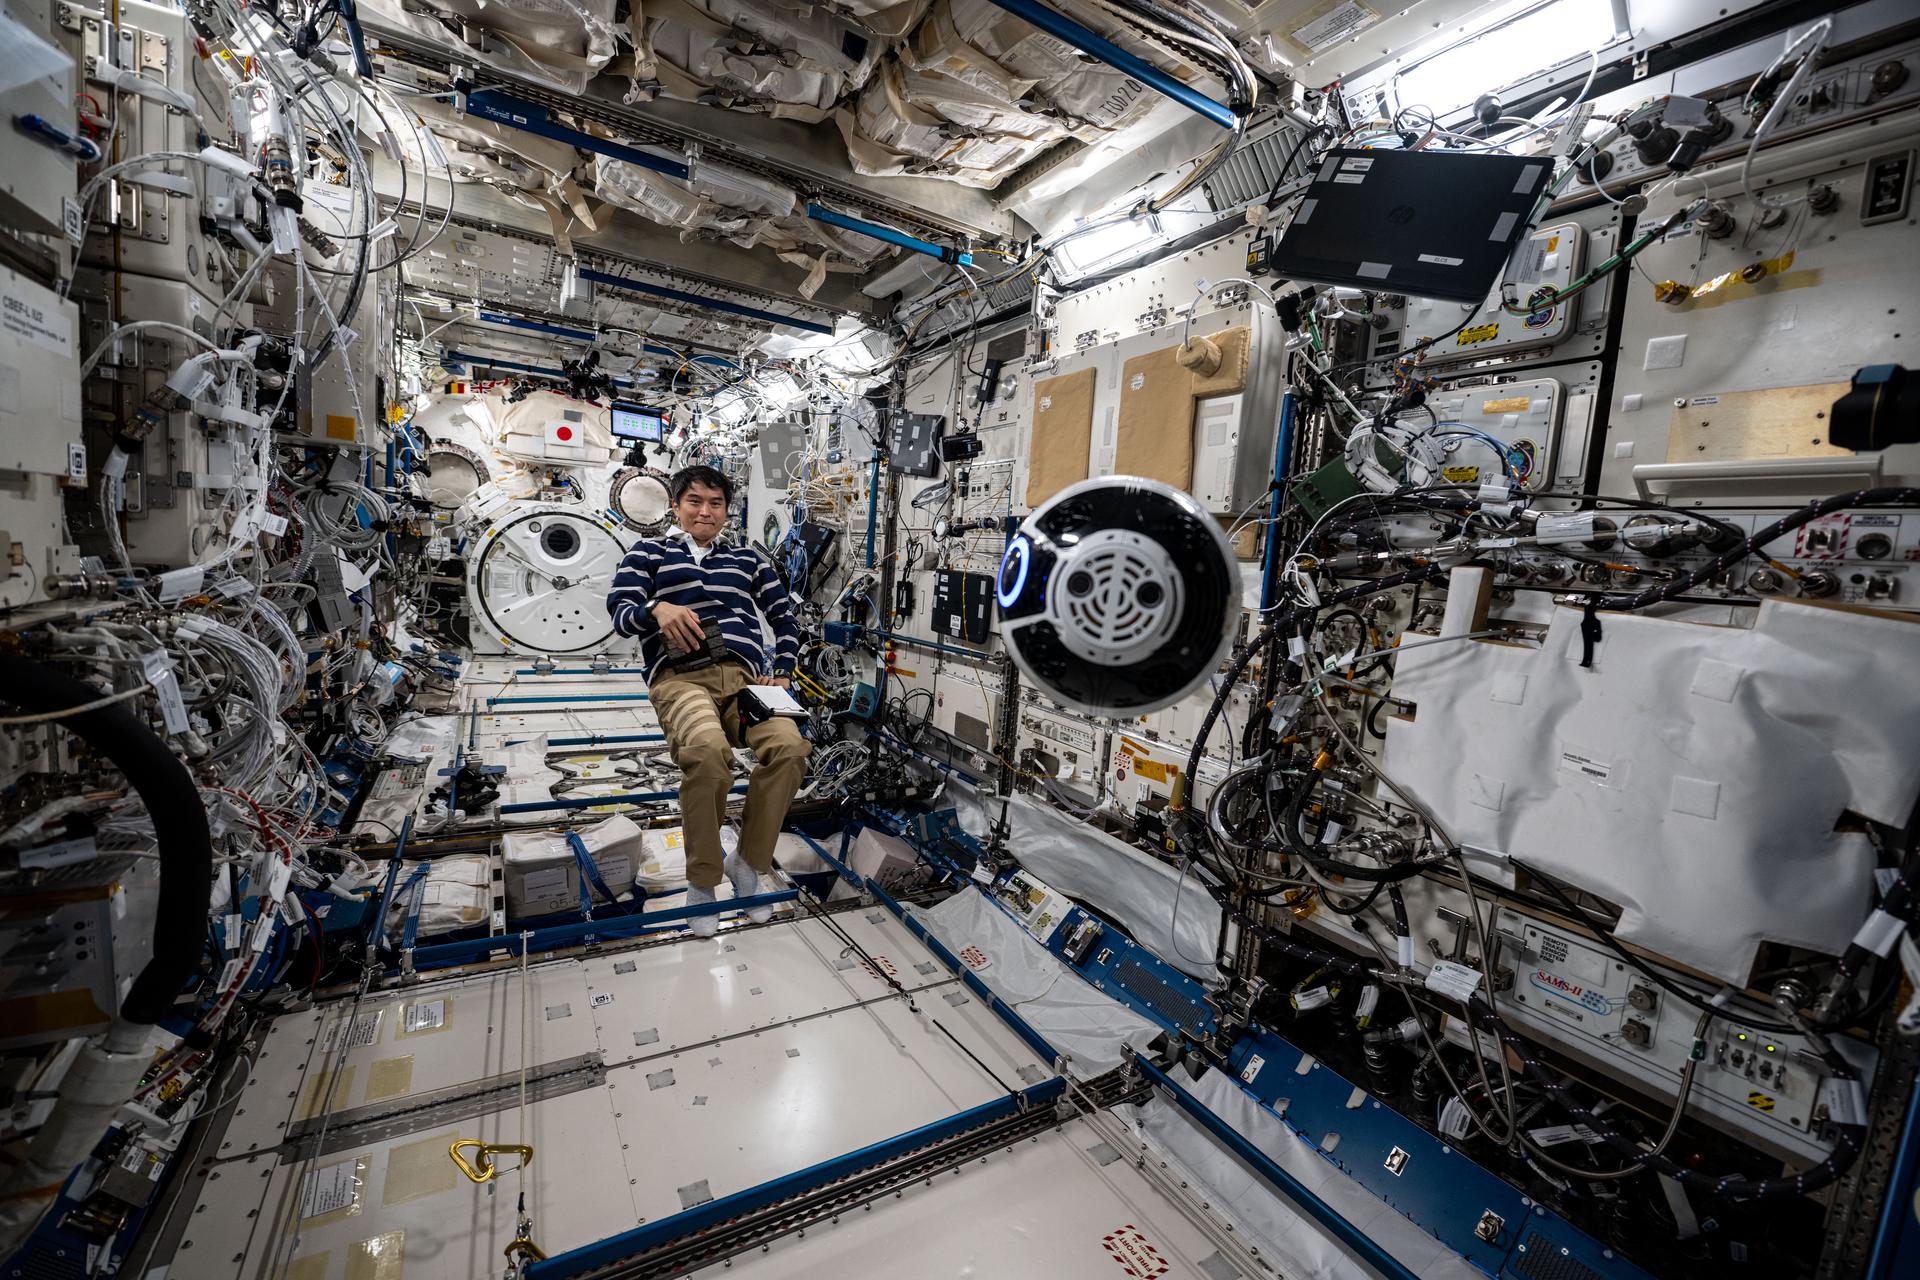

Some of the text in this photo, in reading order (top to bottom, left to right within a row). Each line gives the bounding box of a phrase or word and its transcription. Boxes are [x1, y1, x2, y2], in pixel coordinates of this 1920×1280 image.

[2, 295, 30, 320] CBEF-L
[1541, 946, 1567, 958] SENSOR
[1543, 936, 1568, 949] REMOTE
[1543, 941, 1569, 955] TRIAXIAL
[1541, 951, 1565, 962] SYSTEM
[1537, 970, 1582, 996] SAMS-II
[1110, 1241, 1144, 1278] EMERGENCY USE
[1118, 1237, 1152, 1272] FIRE PORT
